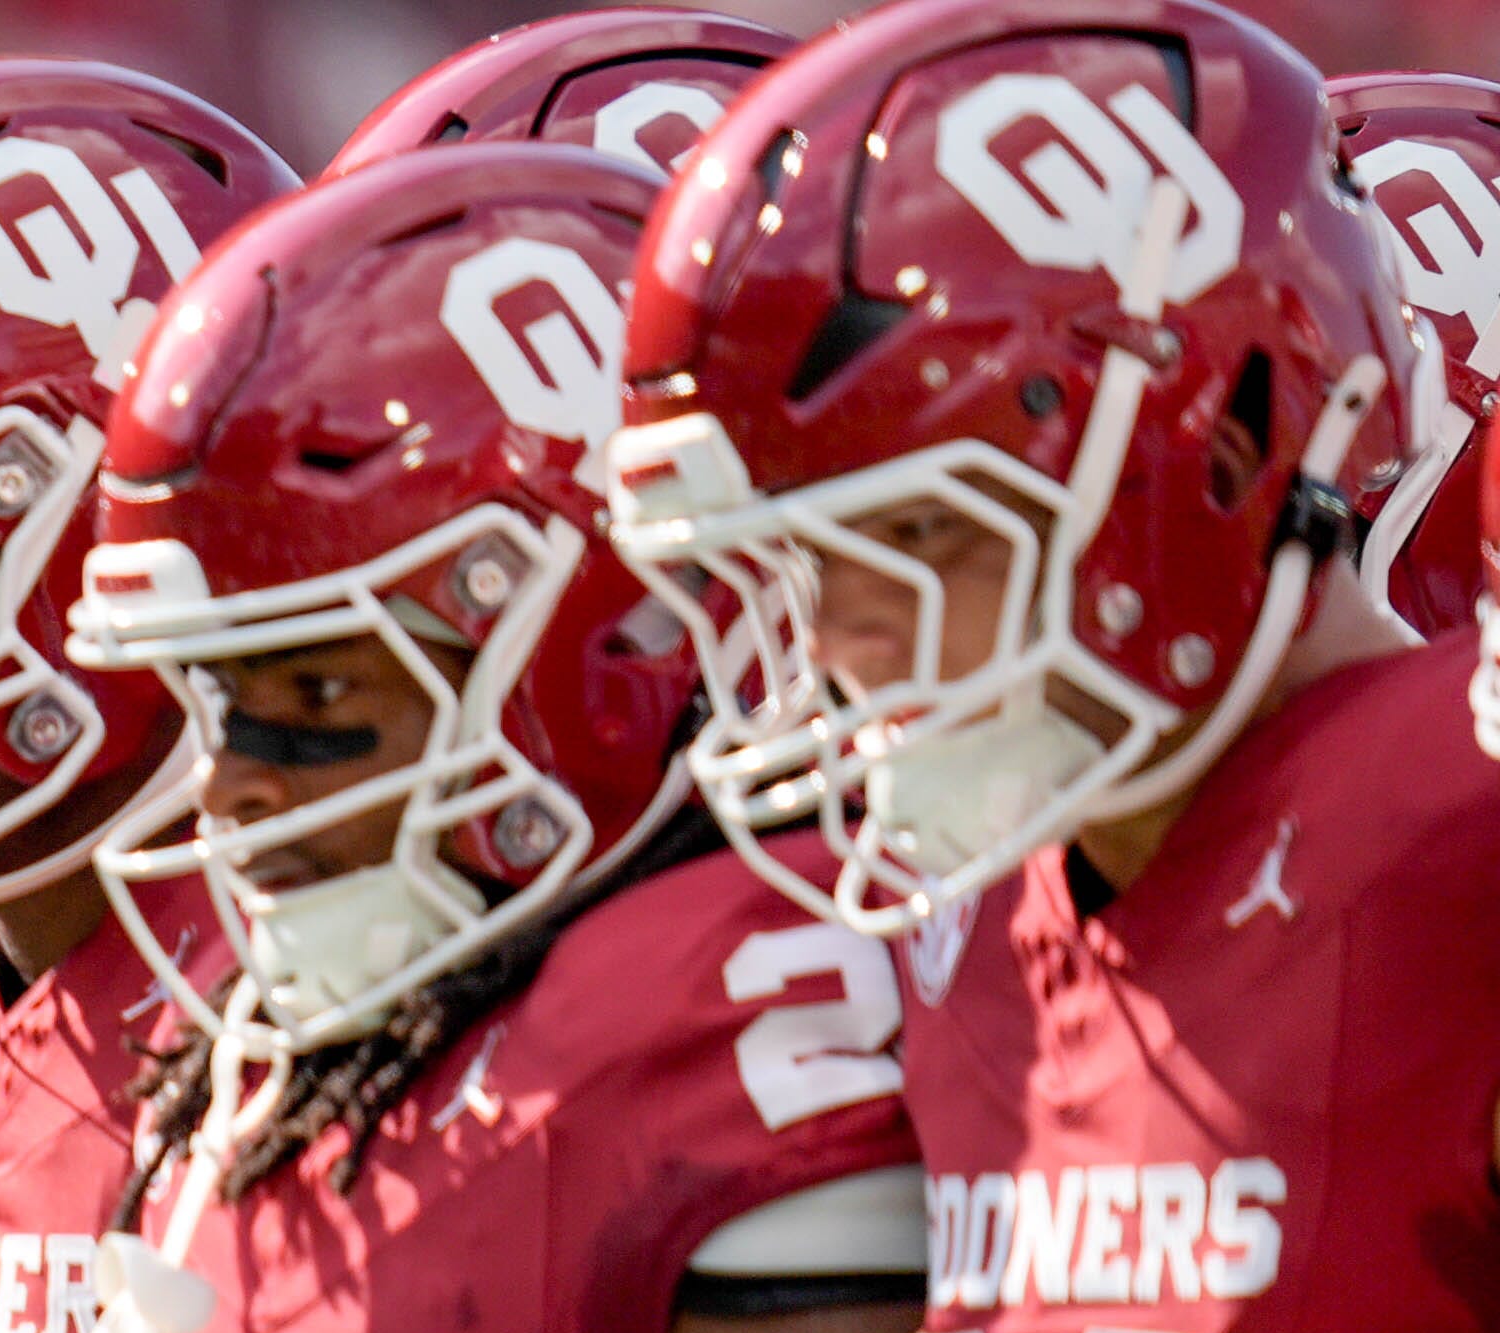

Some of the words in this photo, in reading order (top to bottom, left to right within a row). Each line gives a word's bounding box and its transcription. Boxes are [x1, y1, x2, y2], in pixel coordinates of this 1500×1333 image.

[936, 72, 1243, 306] OU
[1349, 139, 1500, 381] O
[440, 238, 629, 496] O
